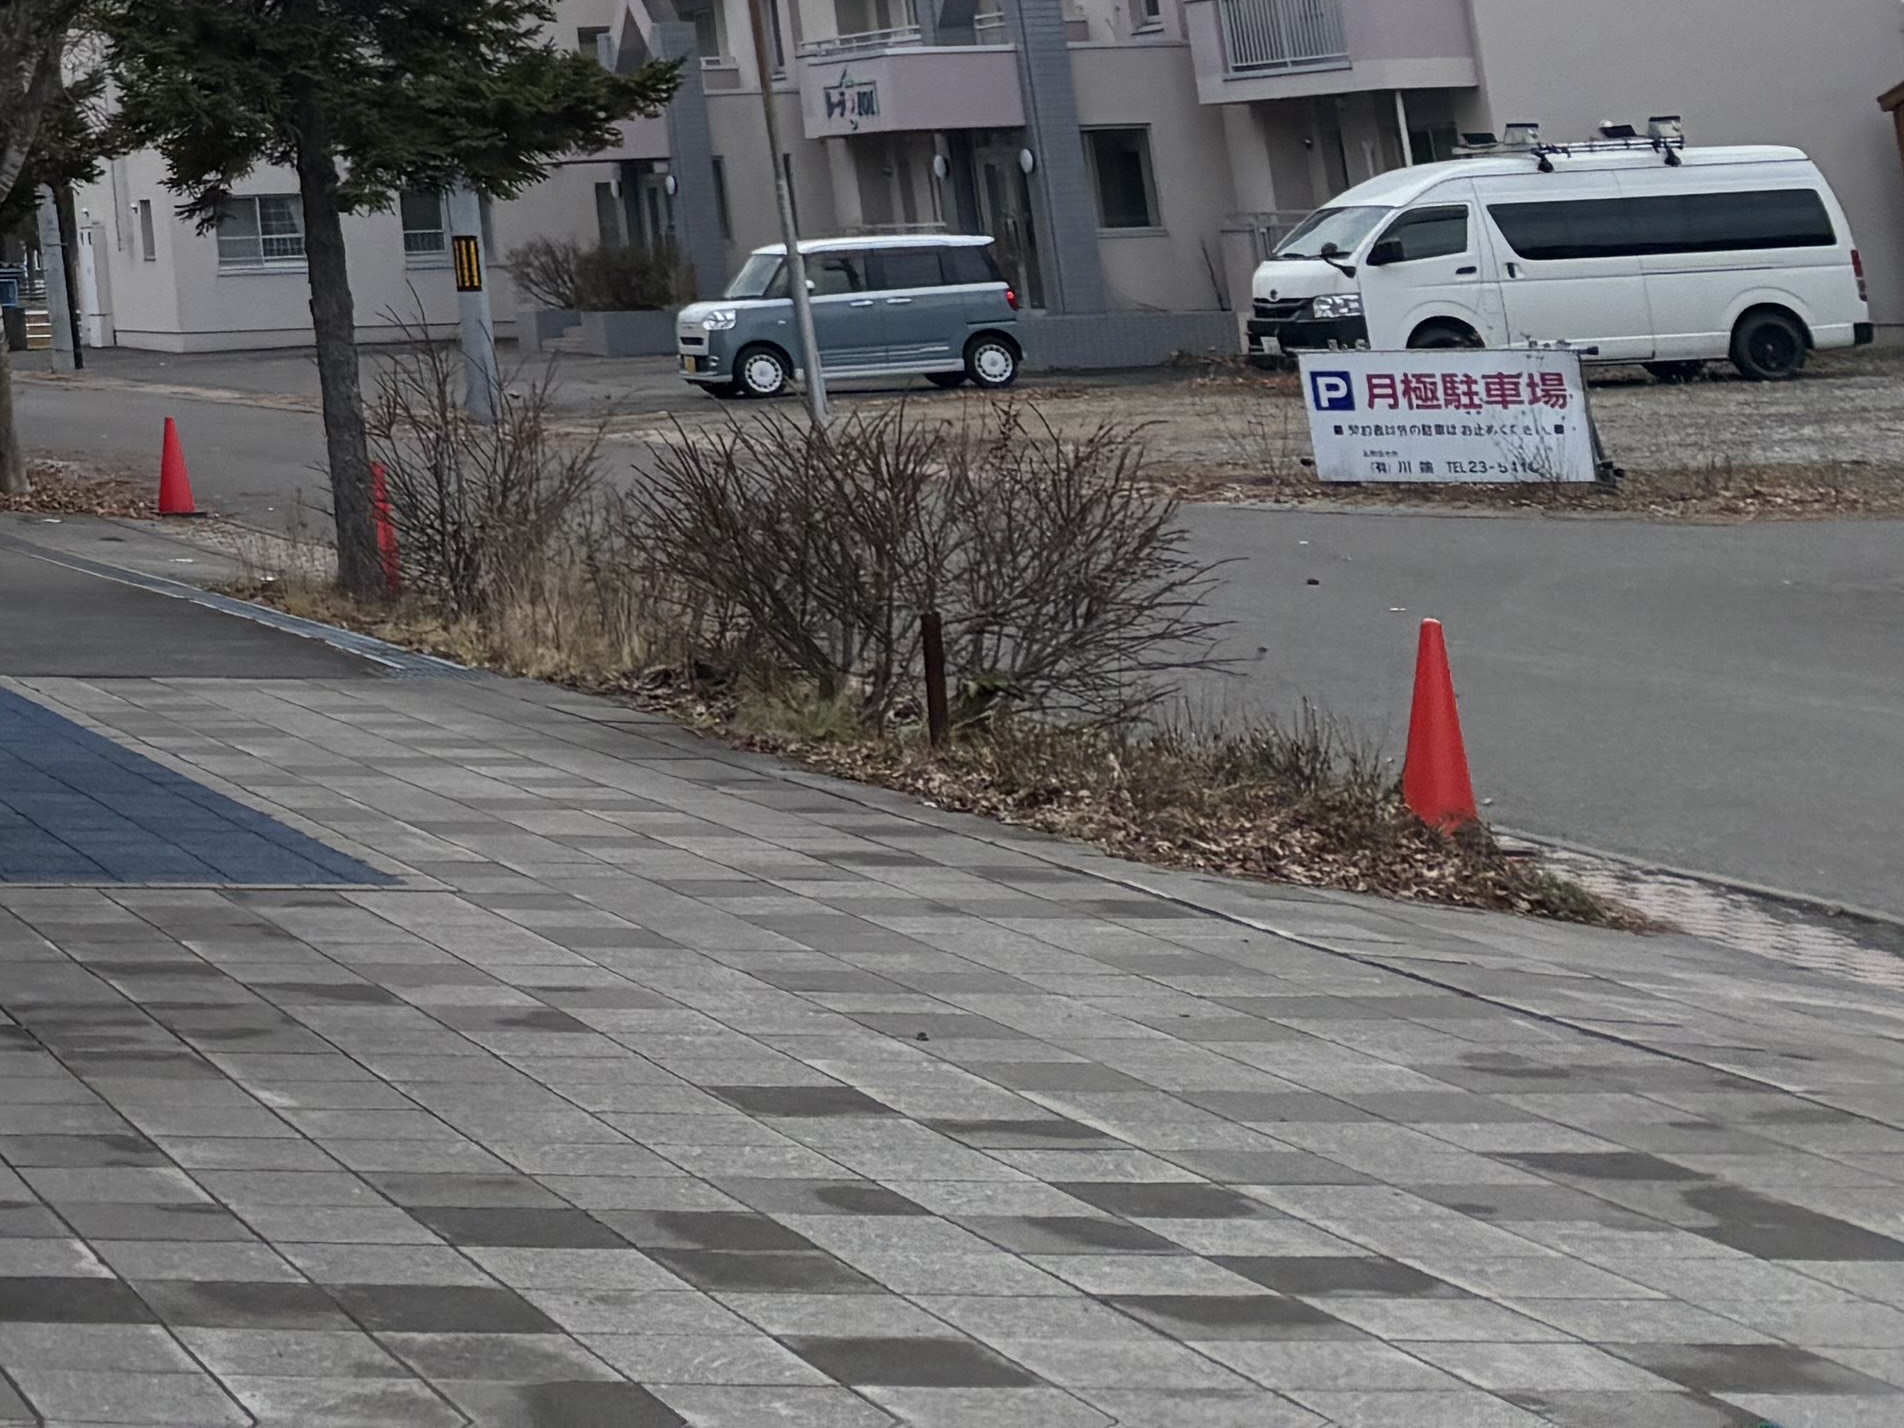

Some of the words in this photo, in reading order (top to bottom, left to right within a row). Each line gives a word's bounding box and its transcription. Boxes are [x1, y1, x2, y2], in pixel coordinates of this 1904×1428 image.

[1317, 376, 1348, 408] P
[1366, 371, 1569, 411] 月極駐車場
